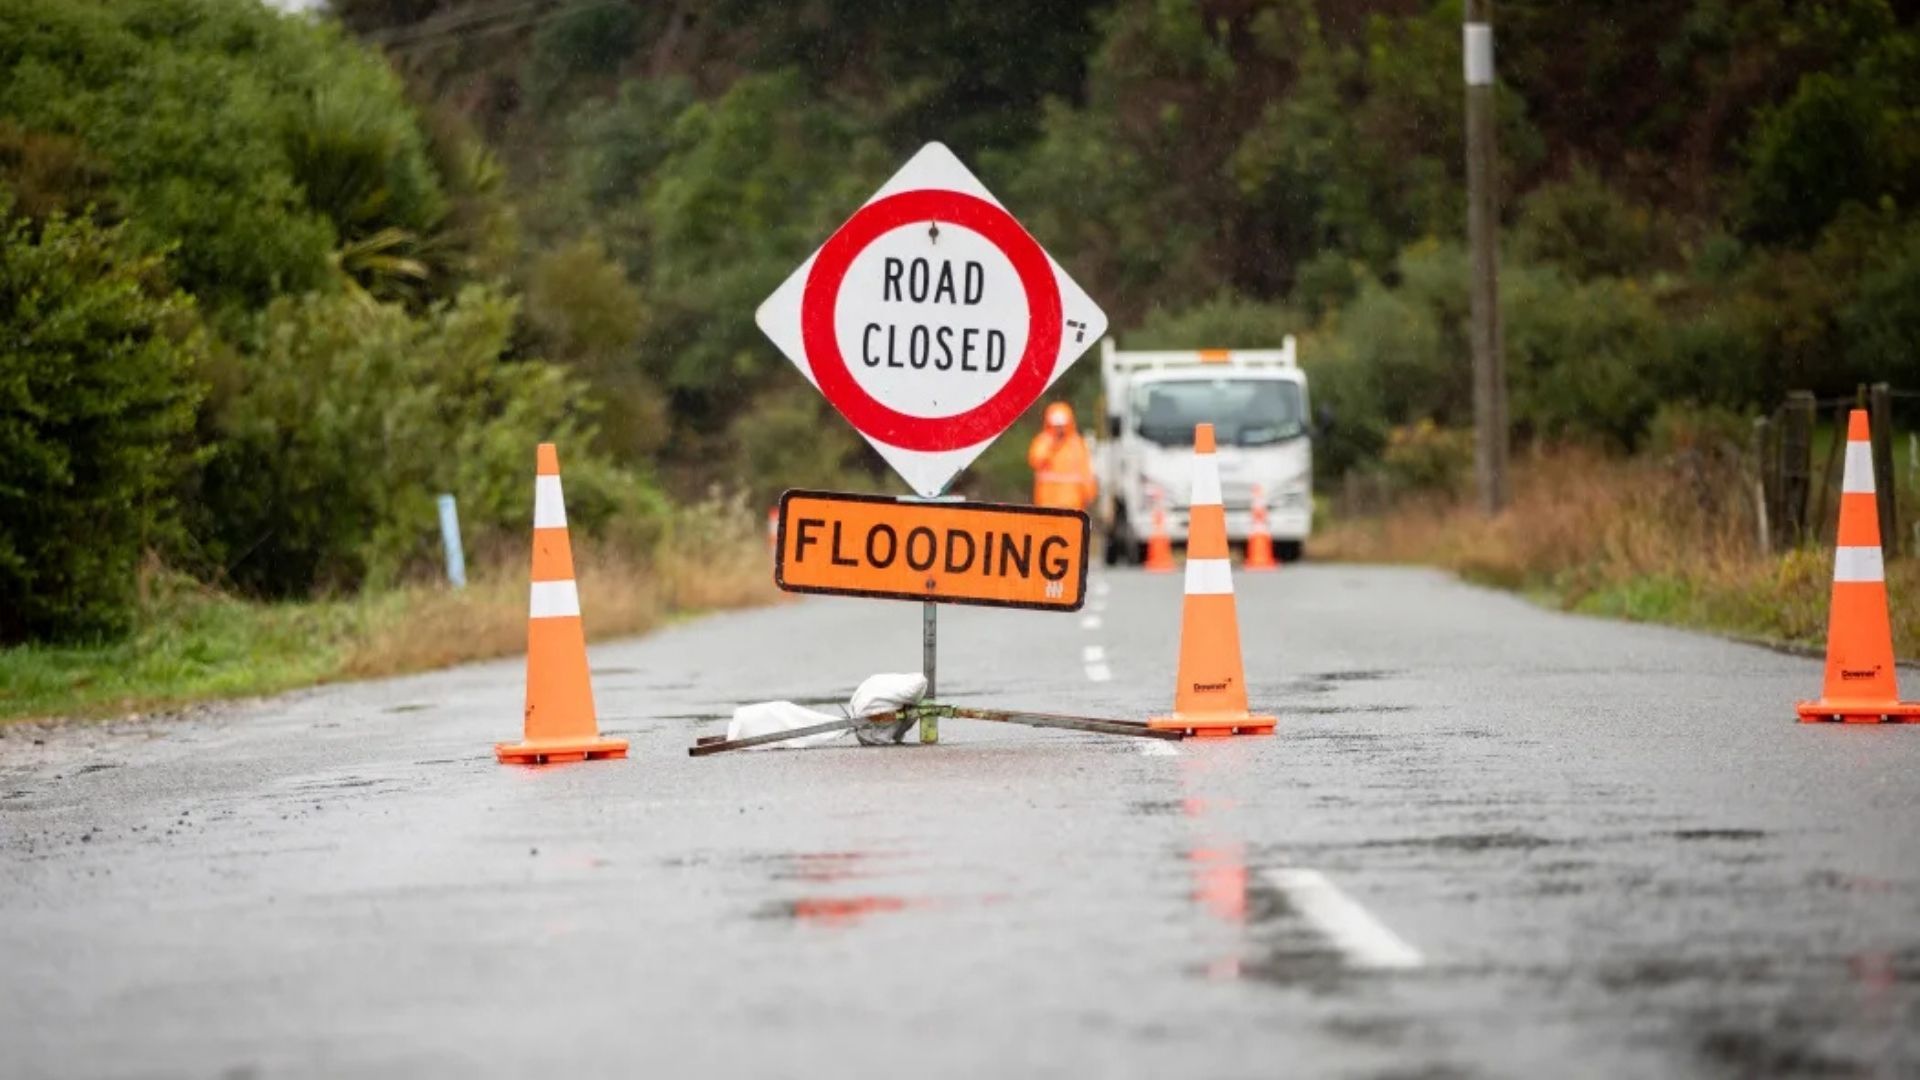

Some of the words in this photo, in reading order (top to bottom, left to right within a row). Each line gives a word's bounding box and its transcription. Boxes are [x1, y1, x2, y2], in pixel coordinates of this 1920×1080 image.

[882, 256, 985, 306] ROAD
[861, 322, 1007, 373] CLOSED
[795, 518, 1070, 583] FLOODING
